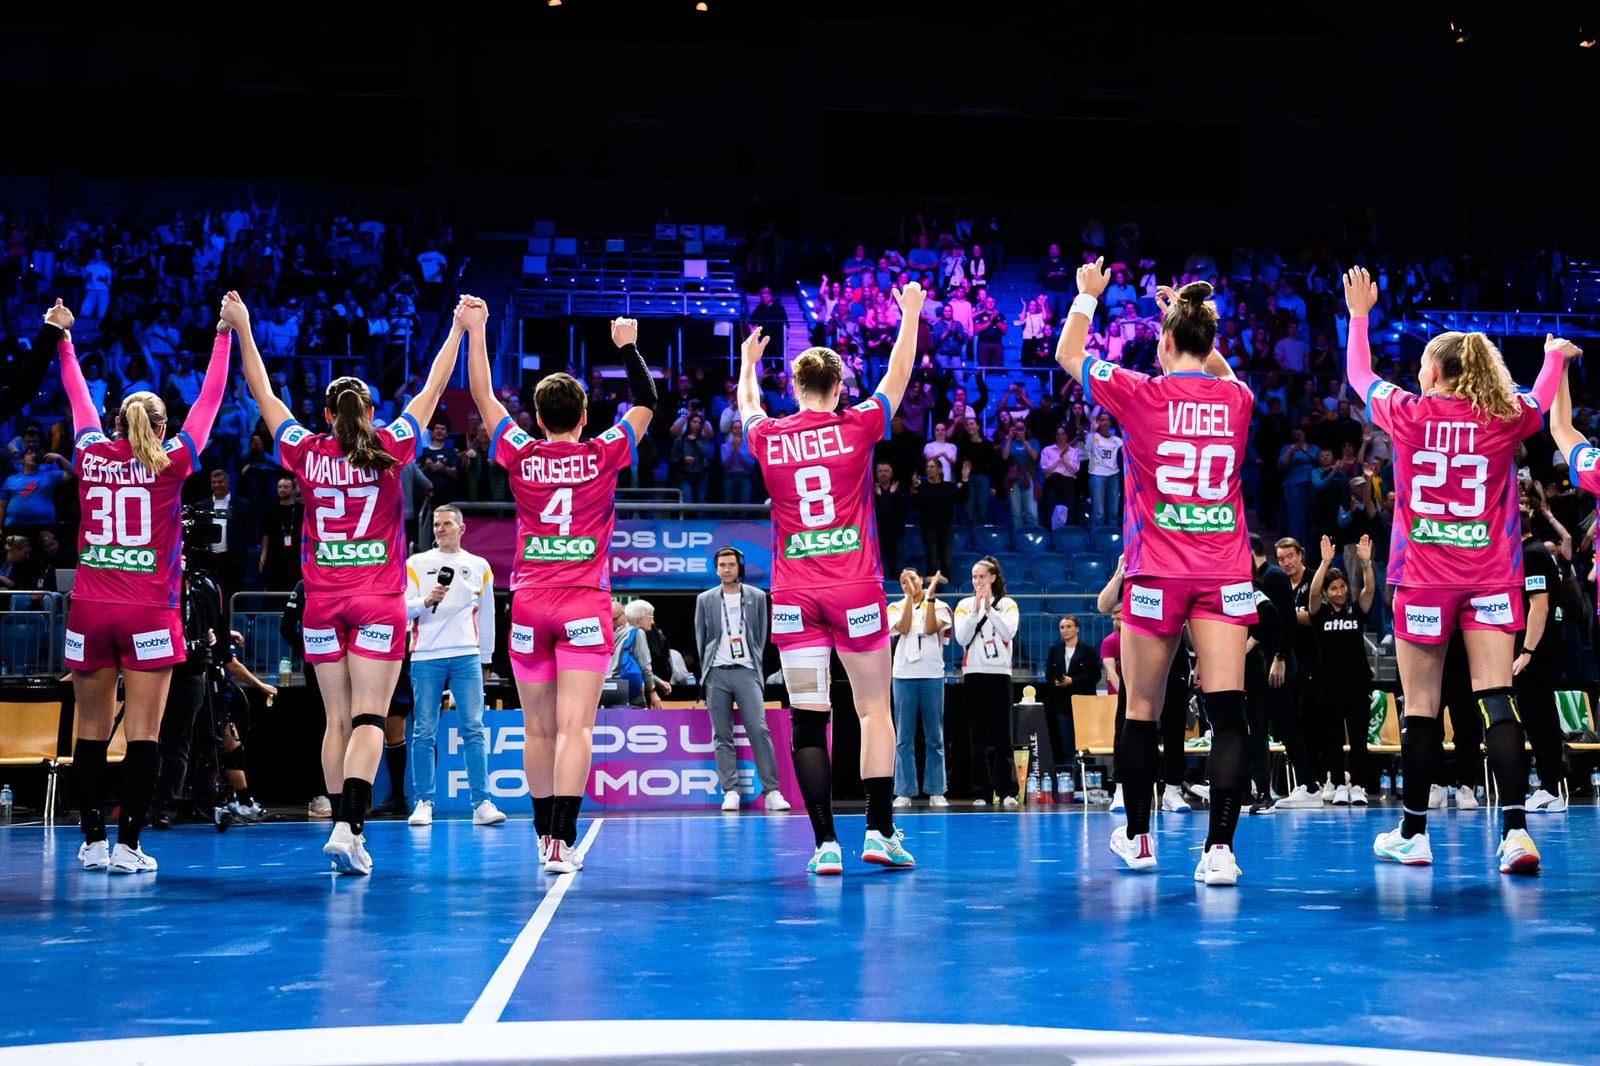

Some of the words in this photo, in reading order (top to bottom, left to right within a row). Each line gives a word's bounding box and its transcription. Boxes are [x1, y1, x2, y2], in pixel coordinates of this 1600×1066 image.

[1168, 400, 1234, 437] VOGEL
[392, 423, 407, 438] DK
[1425, 421, 1478, 453] LOTT
[766, 425, 854, 465] ENGEL
[1101, 449, 1112, 459] 30
[305, 451, 378, 486] MAIDHO
[521, 454, 599, 484] GRIJSEELS
[1155, 440, 1236, 500] 20
[1410, 450, 1489, 517] 23
[794, 465, 837, 528] 8
[85, 486, 152, 546] 30
[313, 485, 379, 540] 27
[540, 487, 573, 535] 4
[1155, 504, 1233, 525] ALSCO
[1410, 518, 1487, 541] ALSCO
[525, 537, 595, 555] ALSCO
[662, 532, 713, 548] UP
[786, 529, 858, 554] ALSCO
[80, 546, 155, 566] ALSCO
[315, 542, 385, 560] ALSCO
[613, 557, 708, 572] MORE
[1527, 577, 1545, 586] DKB
[1132, 592, 1161, 606] brother
[1224, 591, 1253, 603] brothe
[773, 613, 800, 621] other
[849, 611, 879, 625] brother
[1324, 619, 1358, 631] atlas
[1407, 613, 1439, 623] brother
[304, 635, 335, 643] brother
[568, 625, 599, 637] brother
[136, 637, 169, 649] brother
[448, 725, 667, 754] HADS
[1030, 732, 1039, 757] ALLE.
[448, 769, 529, 798] FO
[595, 769, 755, 796] MORE
